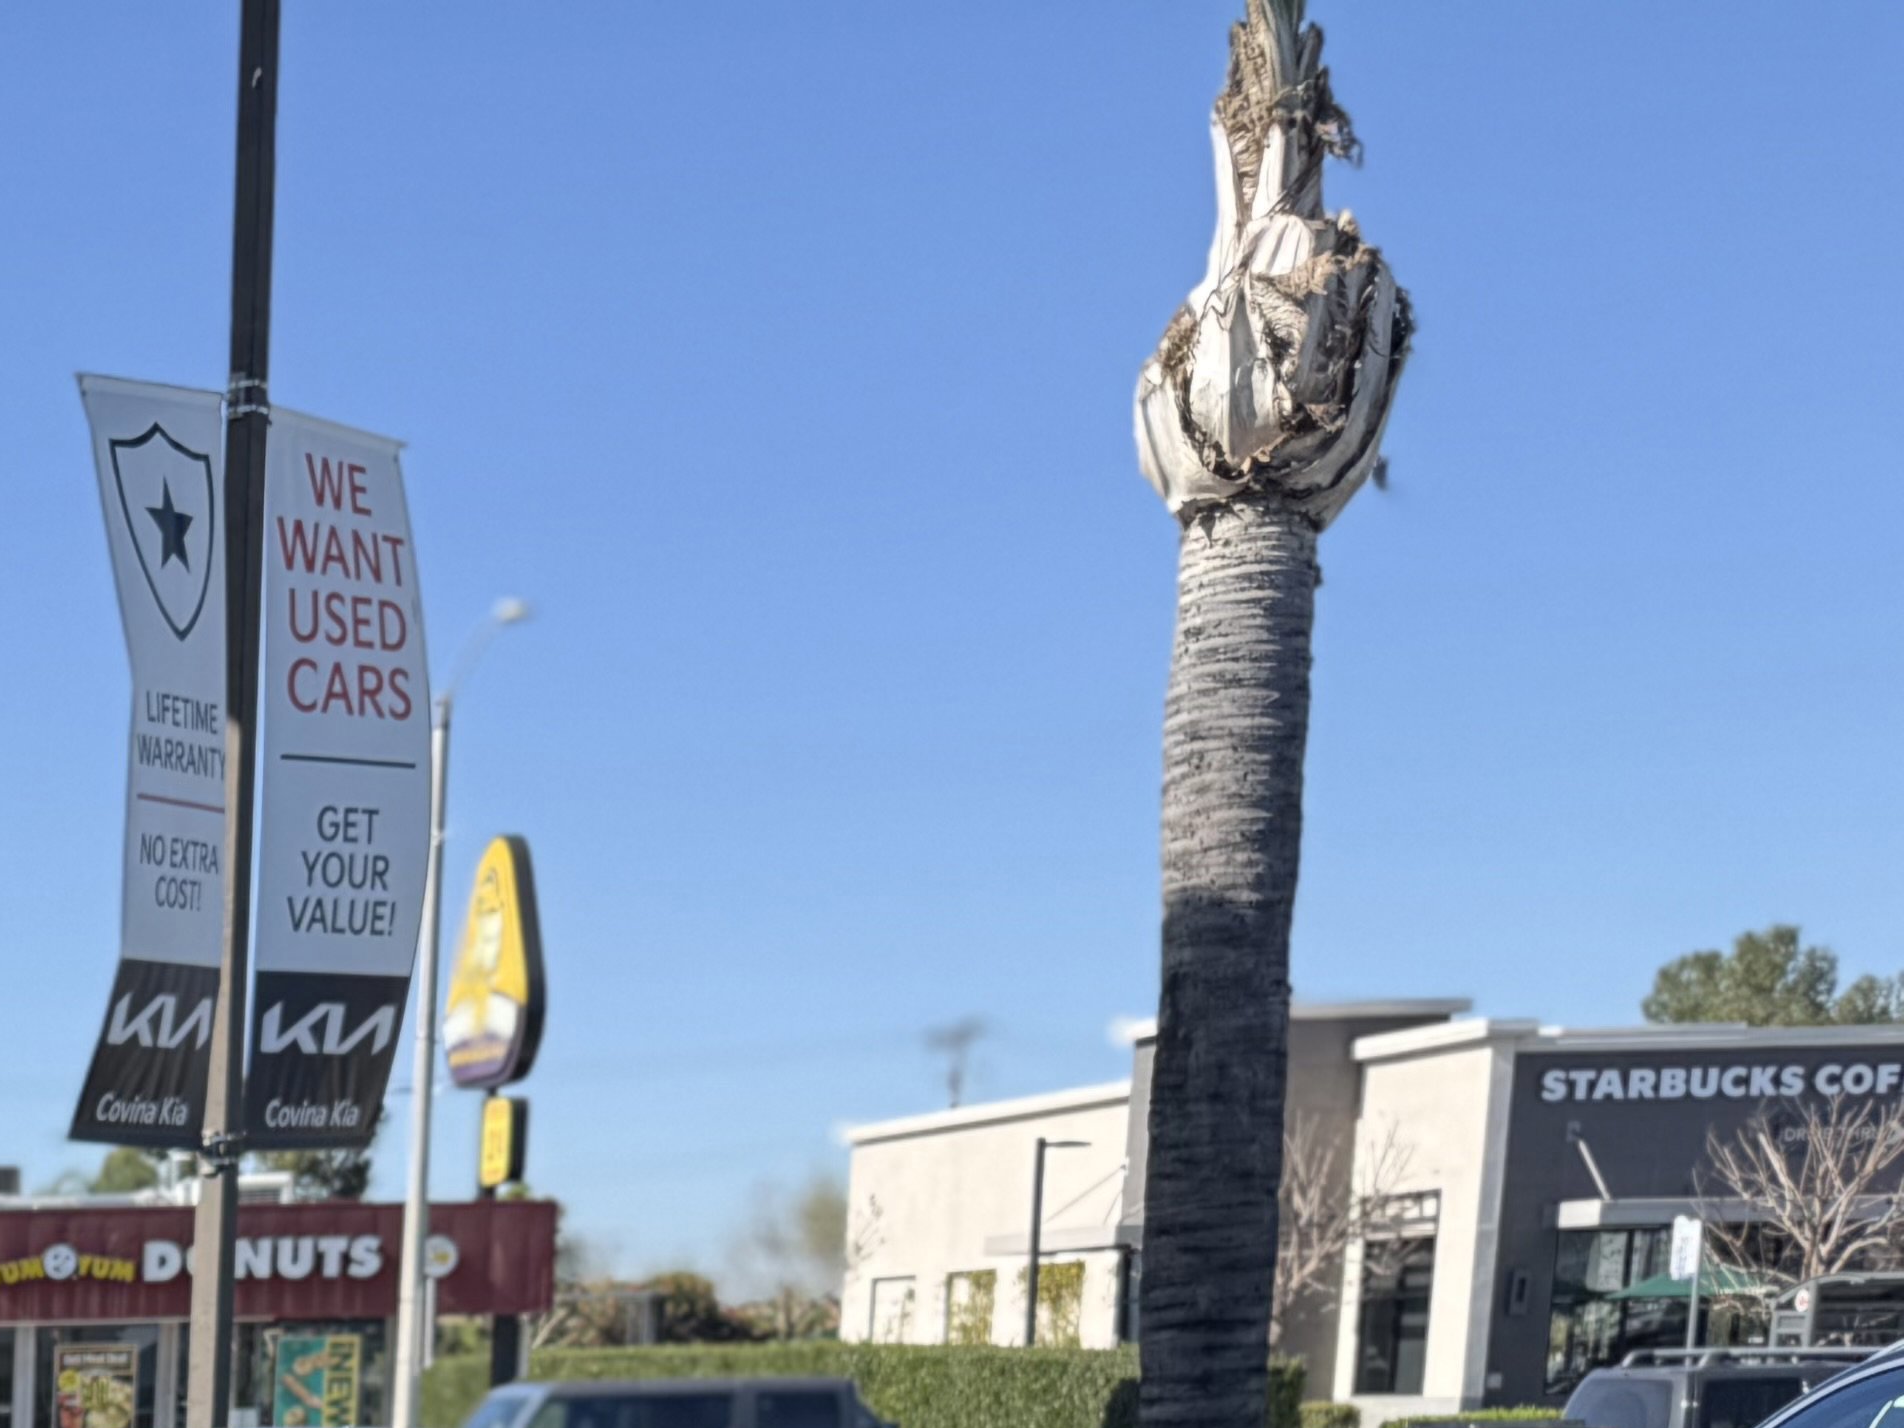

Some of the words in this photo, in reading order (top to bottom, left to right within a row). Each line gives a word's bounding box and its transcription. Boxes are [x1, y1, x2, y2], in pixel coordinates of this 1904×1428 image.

[305, 452, 372, 517] WE
[277, 516, 404, 587] WANT
[288, 588, 407, 652] USED
[287, 657, 412, 721] CARS
[146, 690, 218, 735] LIFETIME
[137, 734, 226, 781] WARRANTY
[317, 805, 380, 845] GET
[140, 833, 165, 866] NO
[170, 837, 219, 875] EXTRA
[301, 851, 390, 891] YOUR
[155, 874, 202, 912] COST!
[287, 896, 396, 937] VALUE!
[106, 992, 214, 1050] KIA
[260, 1002, 397, 1056] KIA
[1541, 1065, 1806, 1102] STARBUCKS
[1814, 1063, 1904, 1096] COF
[96, 1093, 155, 1125] Covina
[158, 1097, 188, 1126] Kia
[265, 1099, 326, 1127] Covina
[329, 1098, 359, 1127] Kia
[78, 1254, 135, 1282] YUM
[143, 1235, 384, 1282] DNUTS
